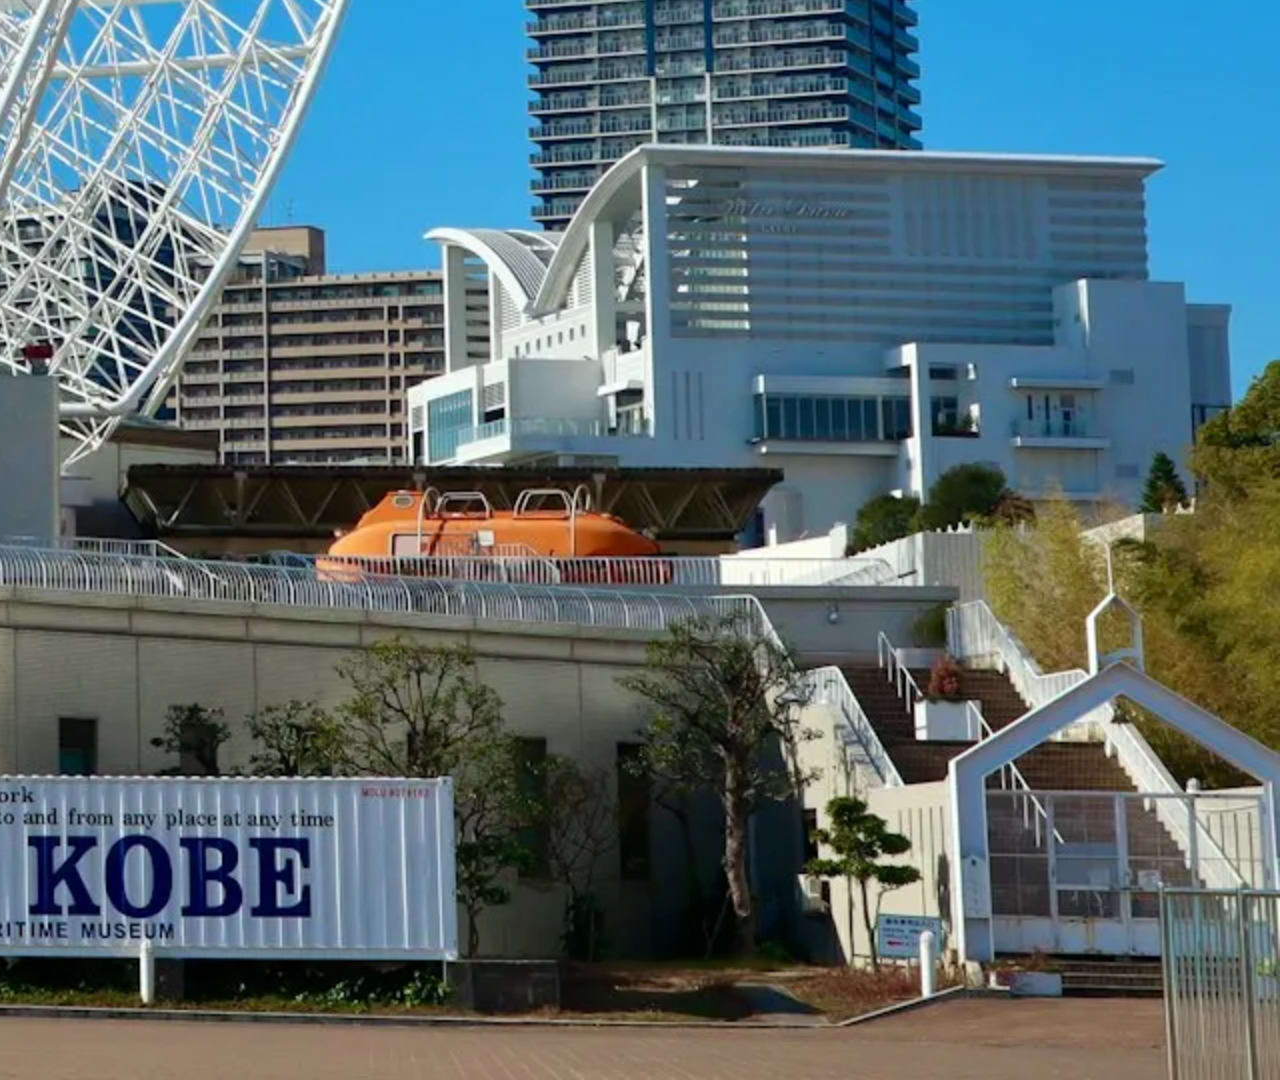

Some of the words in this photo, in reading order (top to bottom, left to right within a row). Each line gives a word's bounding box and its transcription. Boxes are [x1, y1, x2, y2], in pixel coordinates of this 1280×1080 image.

[24, 809, 58, 826] and
[68, 809, 114, 826] from
[123, 814, 157, 831] any
[165, 810, 217, 831] place
[223, 812, 242, 827] at
[248, 814, 282, 831] any
[291, 811, 335, 828] time
[28, 834, 312, 919] KOBE
[81, 921, 176, 940] MUSEUM
